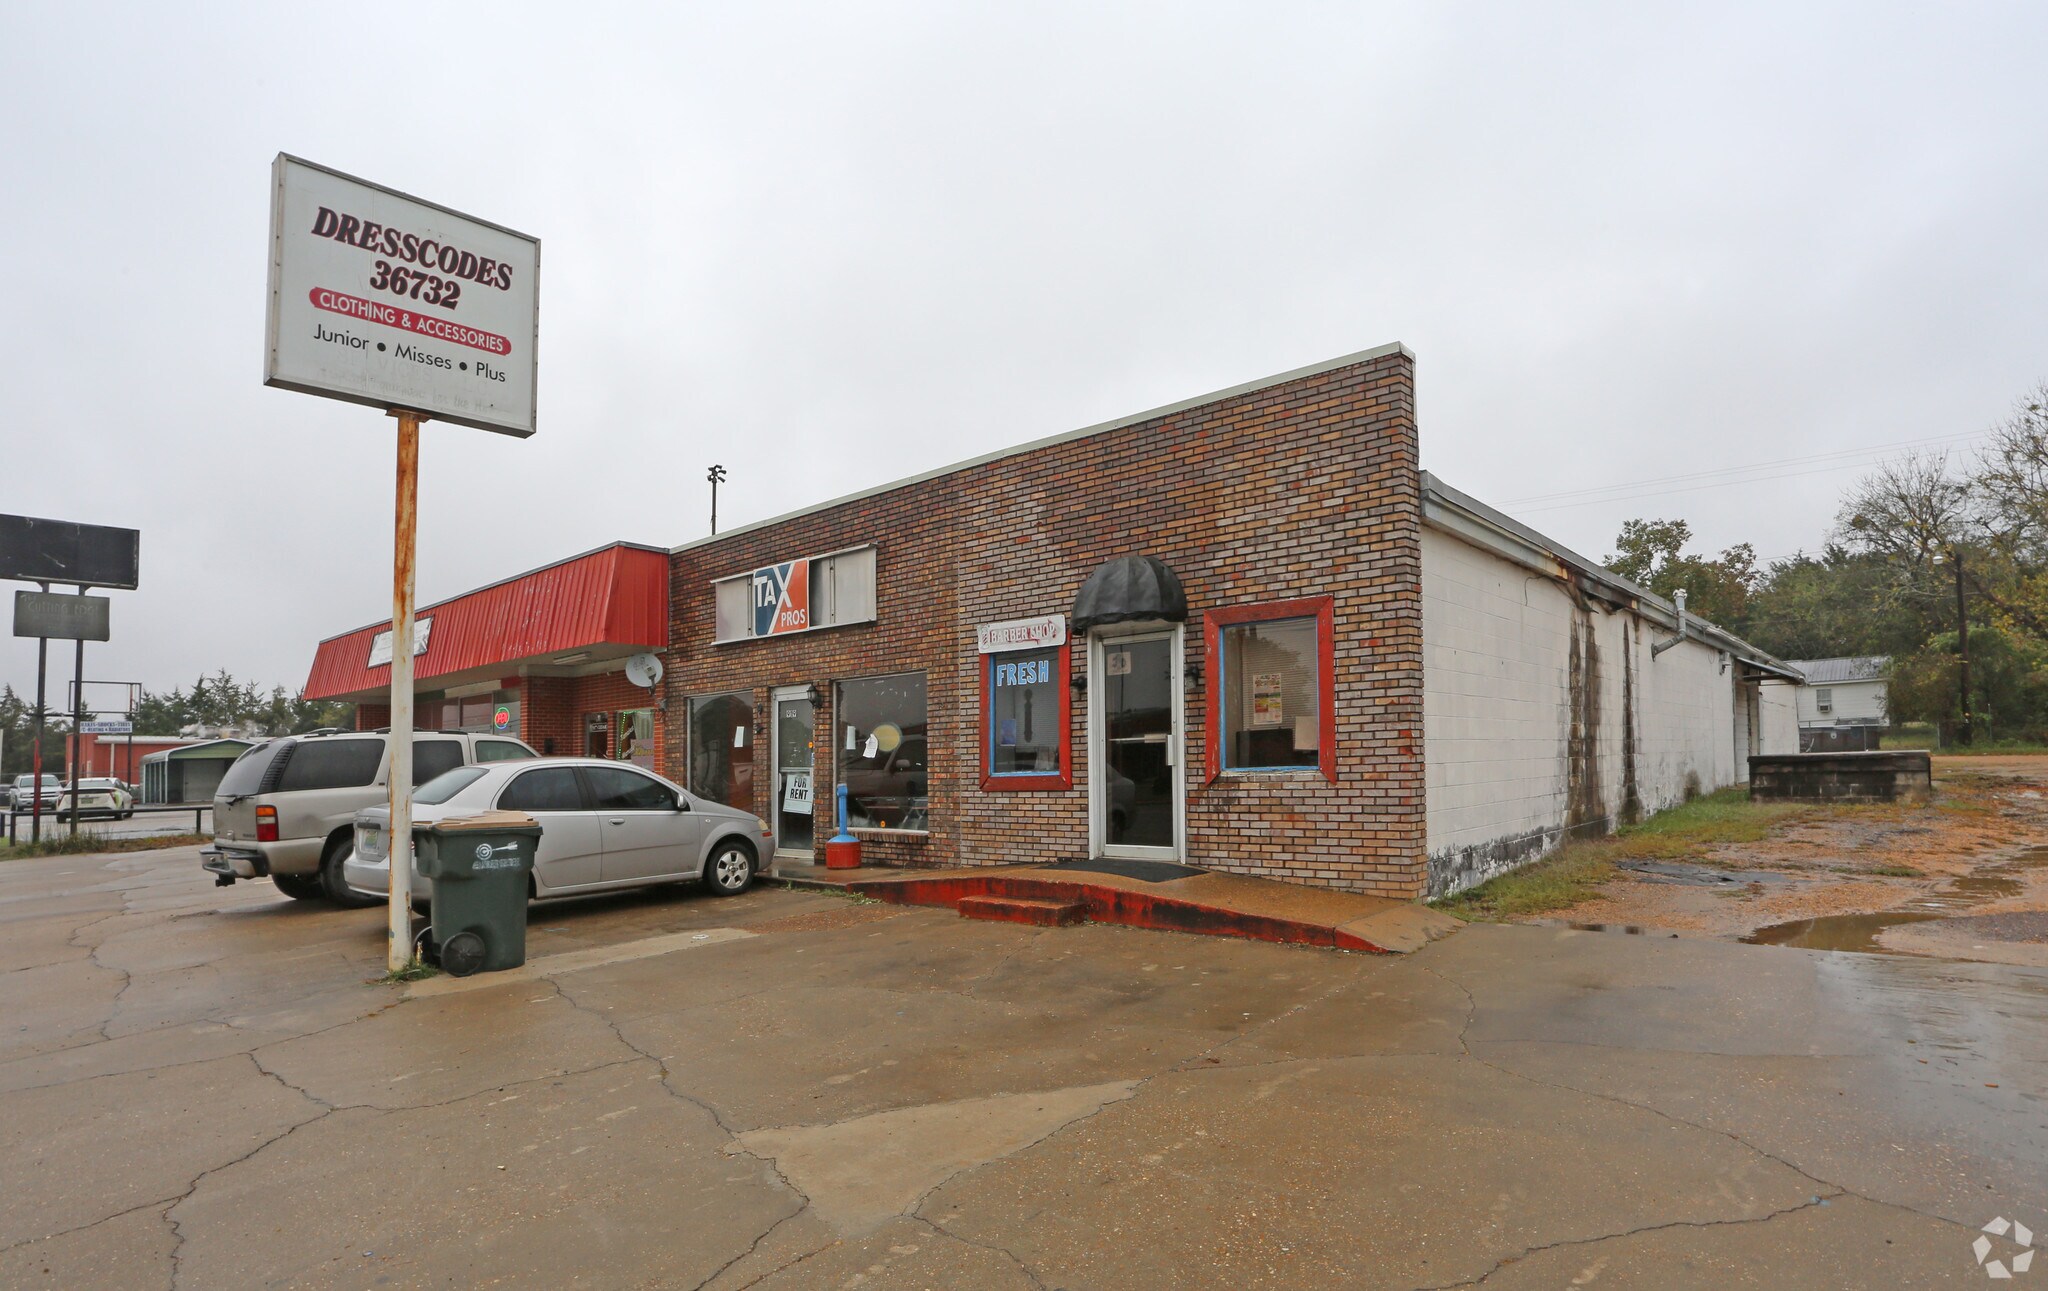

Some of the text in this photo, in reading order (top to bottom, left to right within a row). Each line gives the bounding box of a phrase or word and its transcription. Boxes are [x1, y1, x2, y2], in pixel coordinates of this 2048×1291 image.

[311, 206, 513, 291] DRESSCODES
[370, 260, 461, 310] 36732
[320, 291, 504, 352] CLOTHING & ACCESSORIES
[313, 323, 370, 350] Junior
[395, 343, 452, 370] Misses
[476, 361, 506, 382] Plus
[754, 561, 795, 633] TAX
[781, 608, 806, 627] PROS
[990, 621, 1056, 643] BARBER SHOP
[997, 660, 1049, 686] FRESH
[790, 788, 809, 800] RENT
[793, 776, 807, 788] FOR
